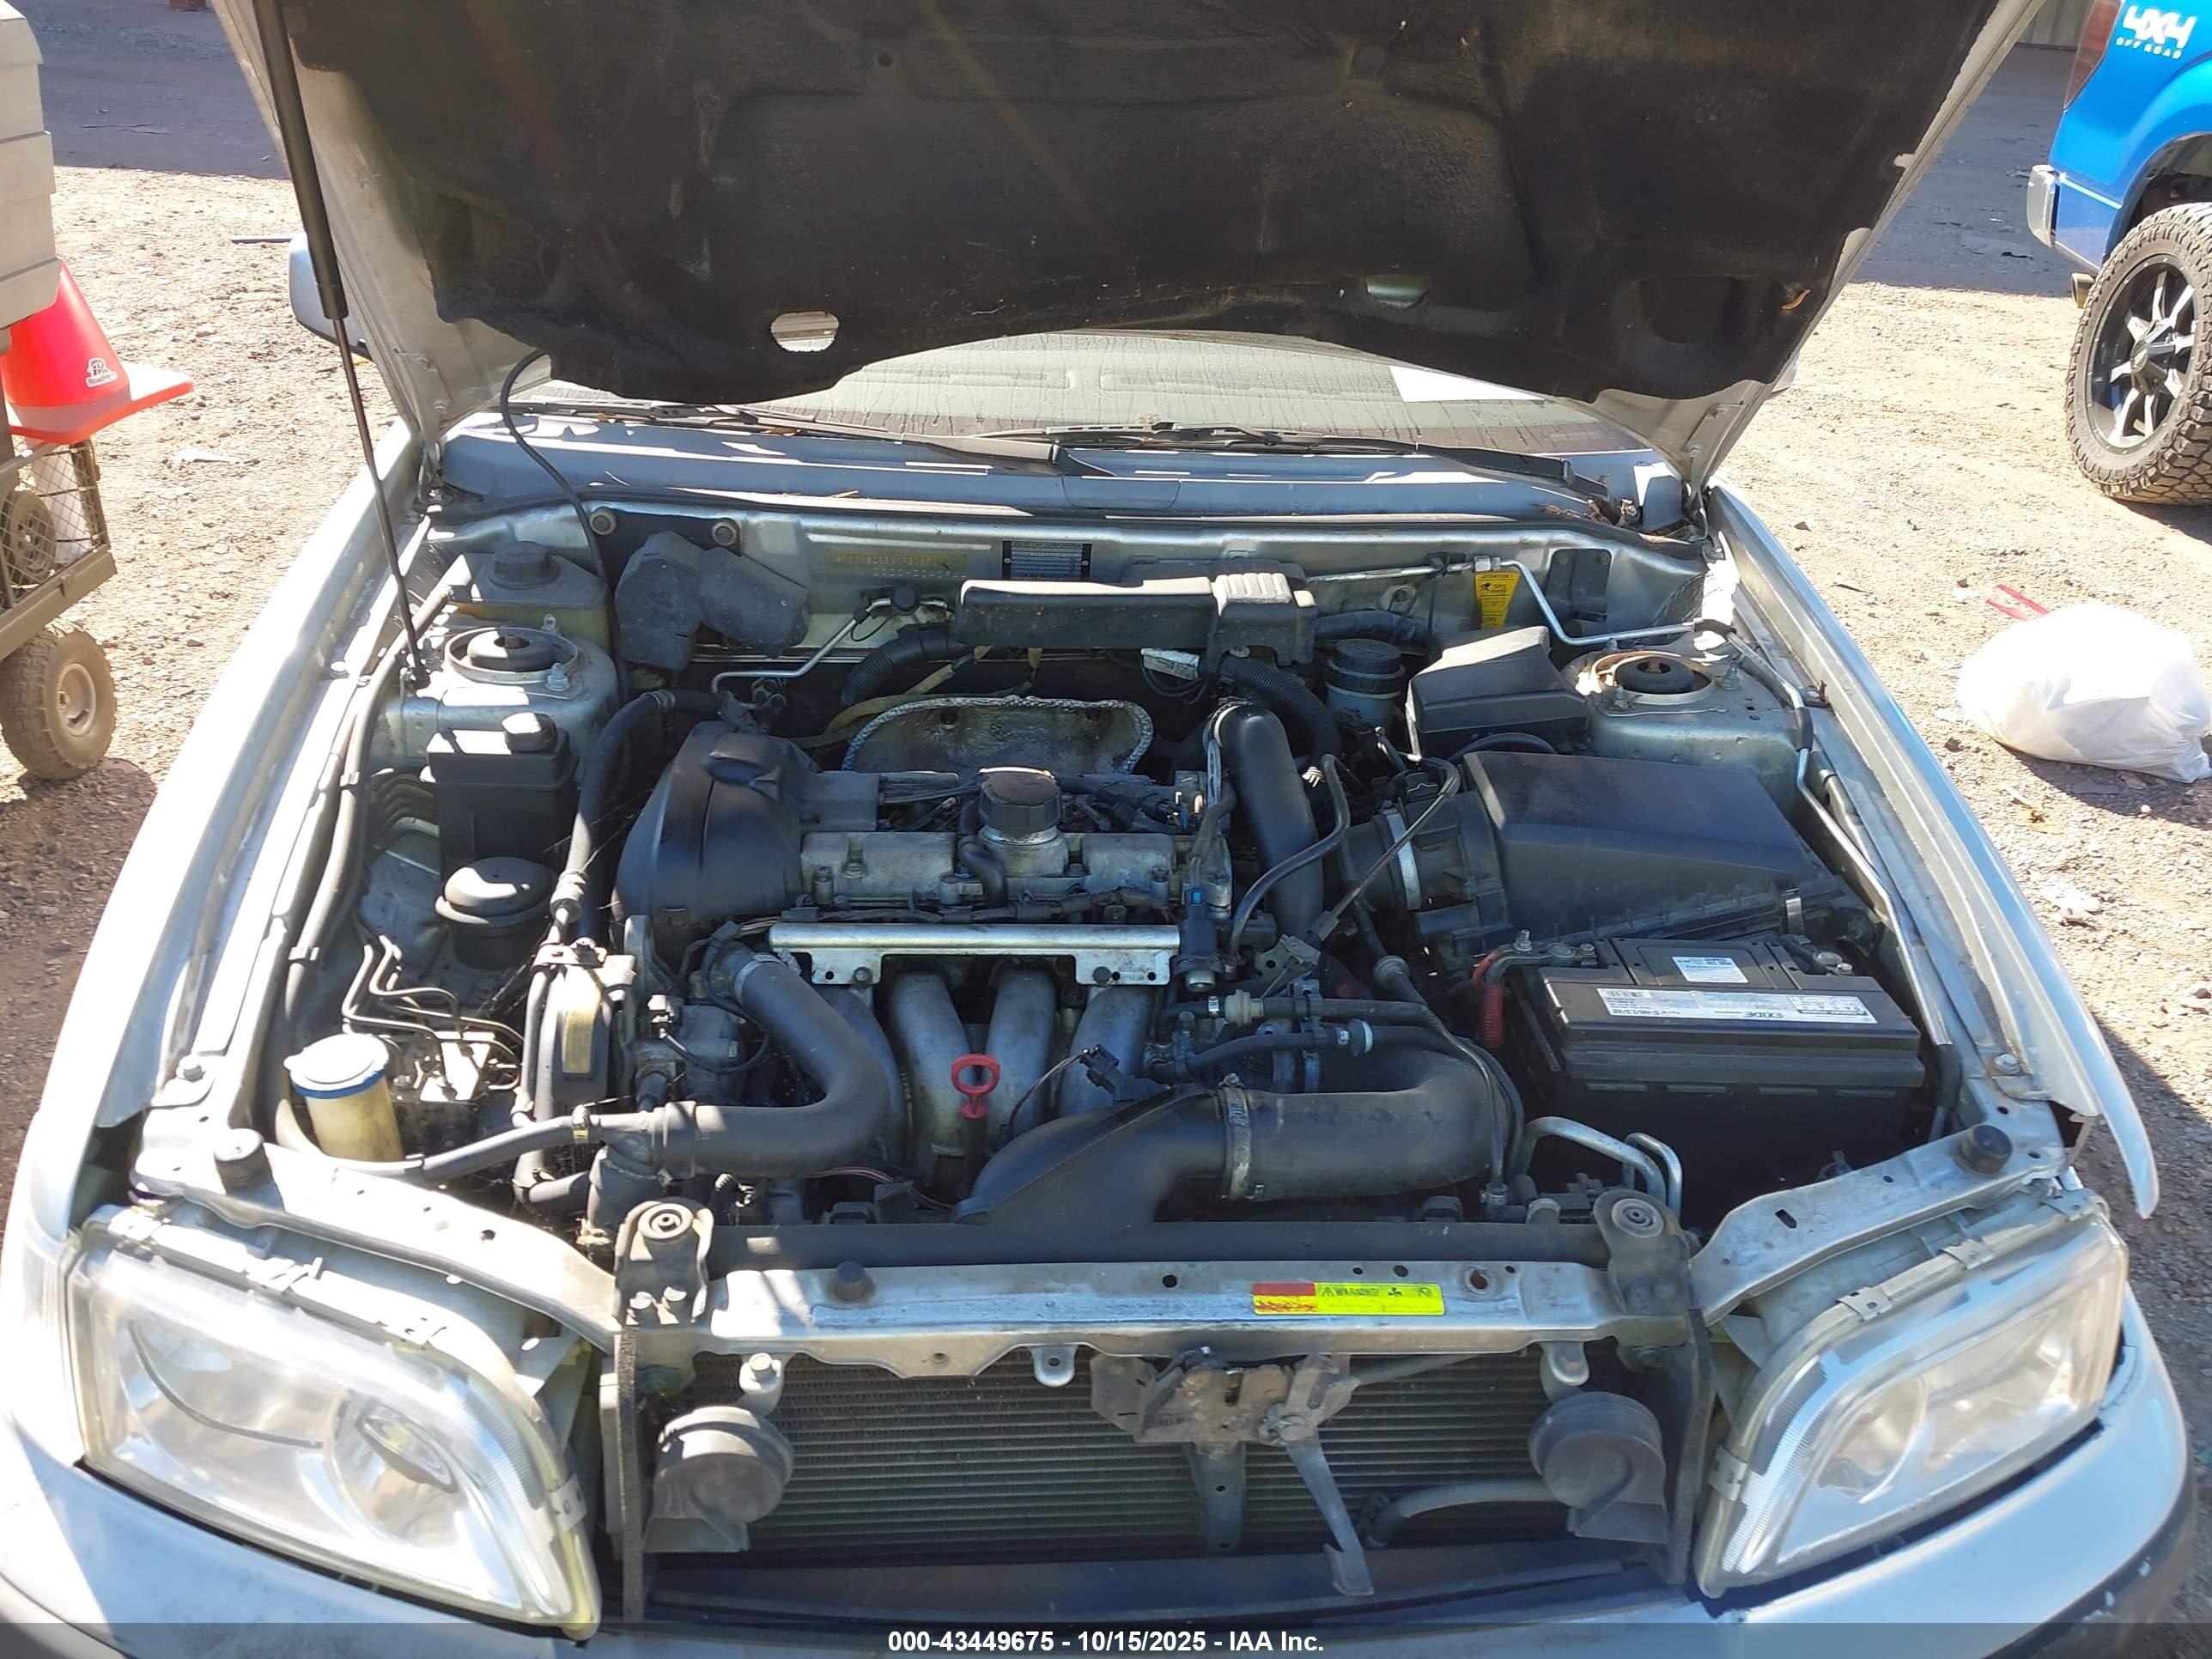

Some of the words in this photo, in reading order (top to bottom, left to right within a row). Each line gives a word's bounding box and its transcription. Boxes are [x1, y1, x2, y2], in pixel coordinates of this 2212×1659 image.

[2115, 37, 2142, 49] OFF
[2143, 44, 2182, 59] ROAD
[1743, 1011, 1784, 1019] EXIDE
